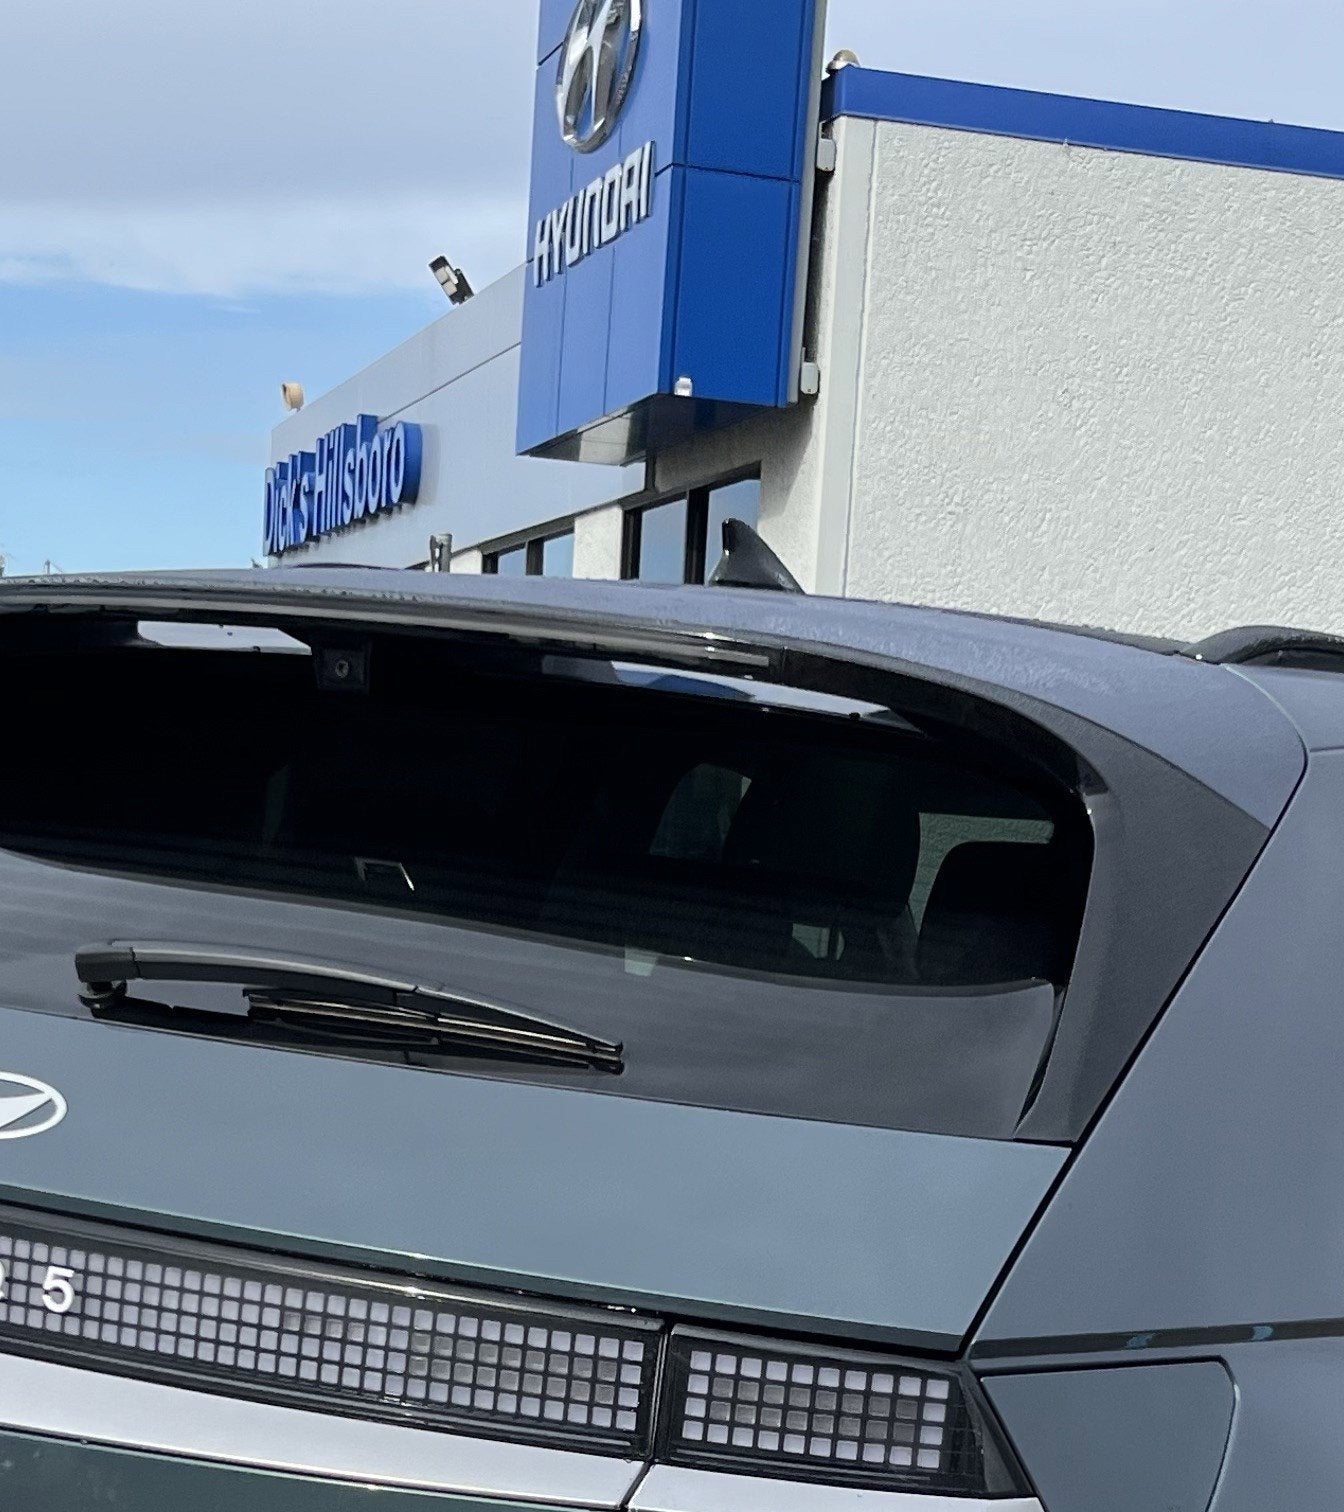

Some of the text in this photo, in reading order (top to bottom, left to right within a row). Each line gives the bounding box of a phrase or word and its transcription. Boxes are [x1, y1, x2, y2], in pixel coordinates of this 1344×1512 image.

[533, 140, 654, 287] HYUNDAI
[263, 414, 421, 556] Dick's Hillsboro
[42, 1266, 75, 1314] 5
